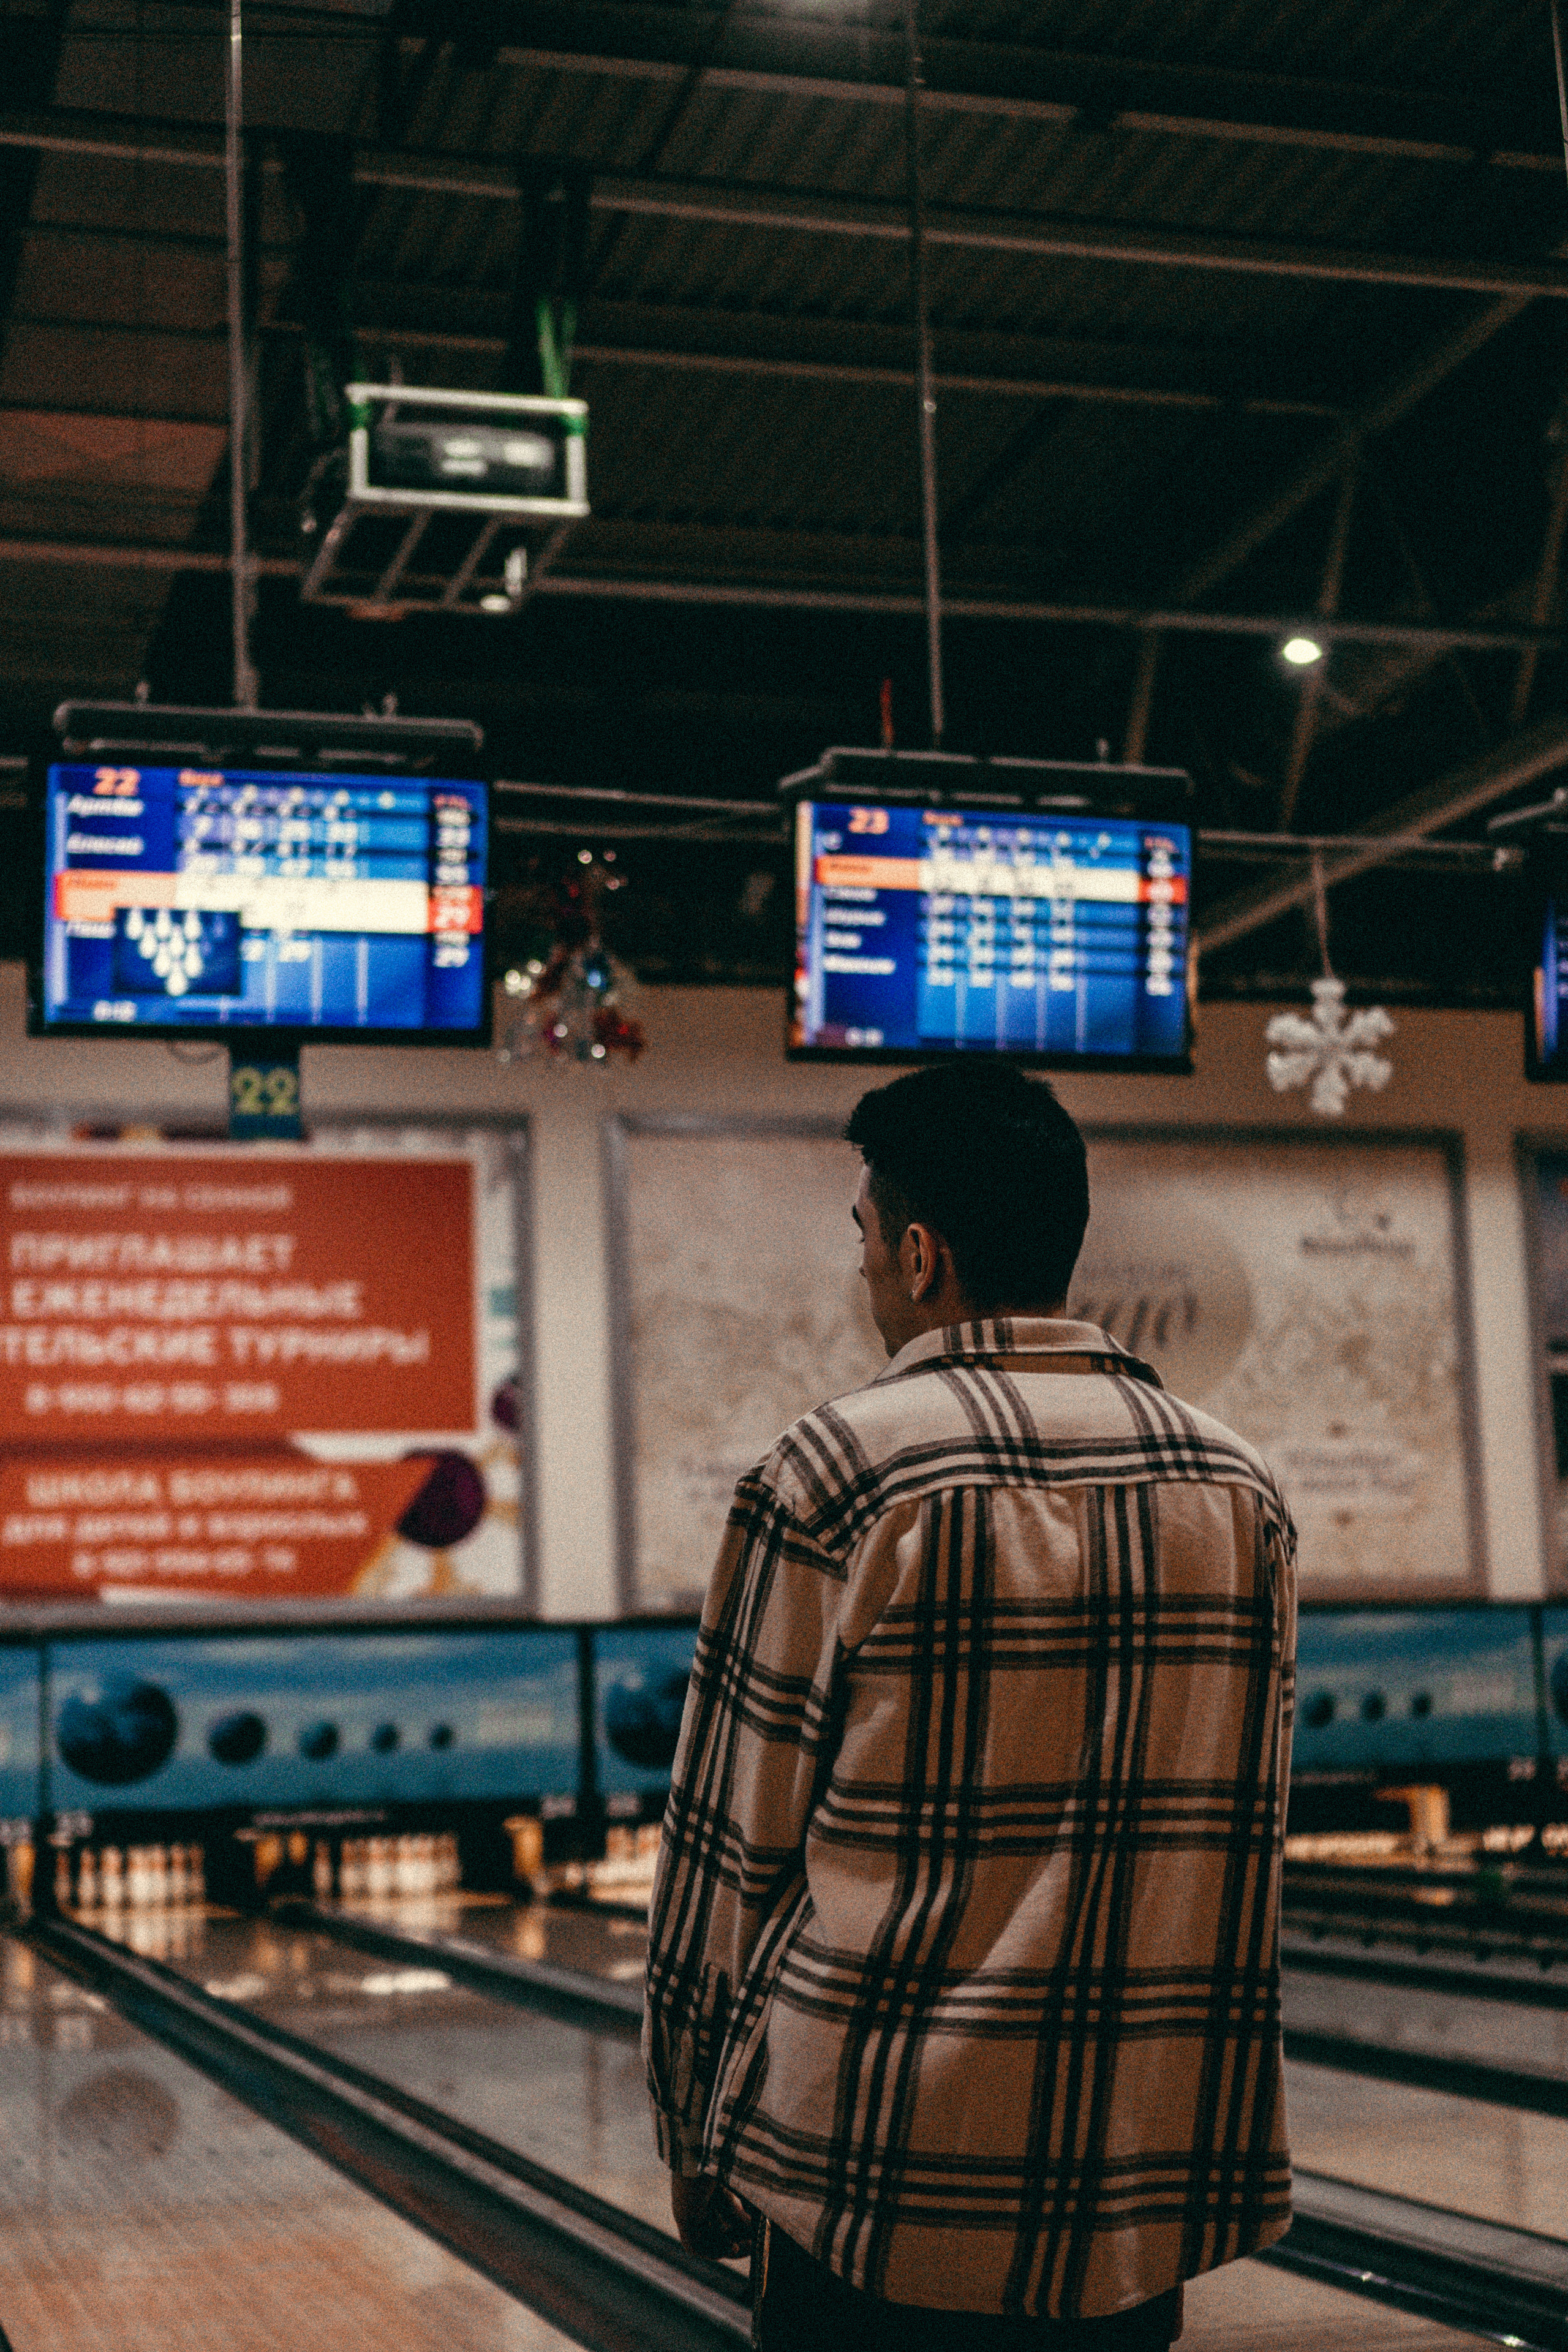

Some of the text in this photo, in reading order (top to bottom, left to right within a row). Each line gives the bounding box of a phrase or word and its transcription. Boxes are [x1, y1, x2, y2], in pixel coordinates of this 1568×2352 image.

[94, 767, 140, 796] 22
[848, 808, 889, 834] 23
[233, 1066, 296, 1116] 22
[10, 1234, 295, 1270] ПРИГЛАШАЕТ
[12, 1281, 363, 1319] ЕЖЕНЕДЕЛЬНЫЕ
[229, 1328, 429, 1363] ТУРНИРЫ
[26, 1471, 358, 1506] ШКОЛА БОУЛИНГА
